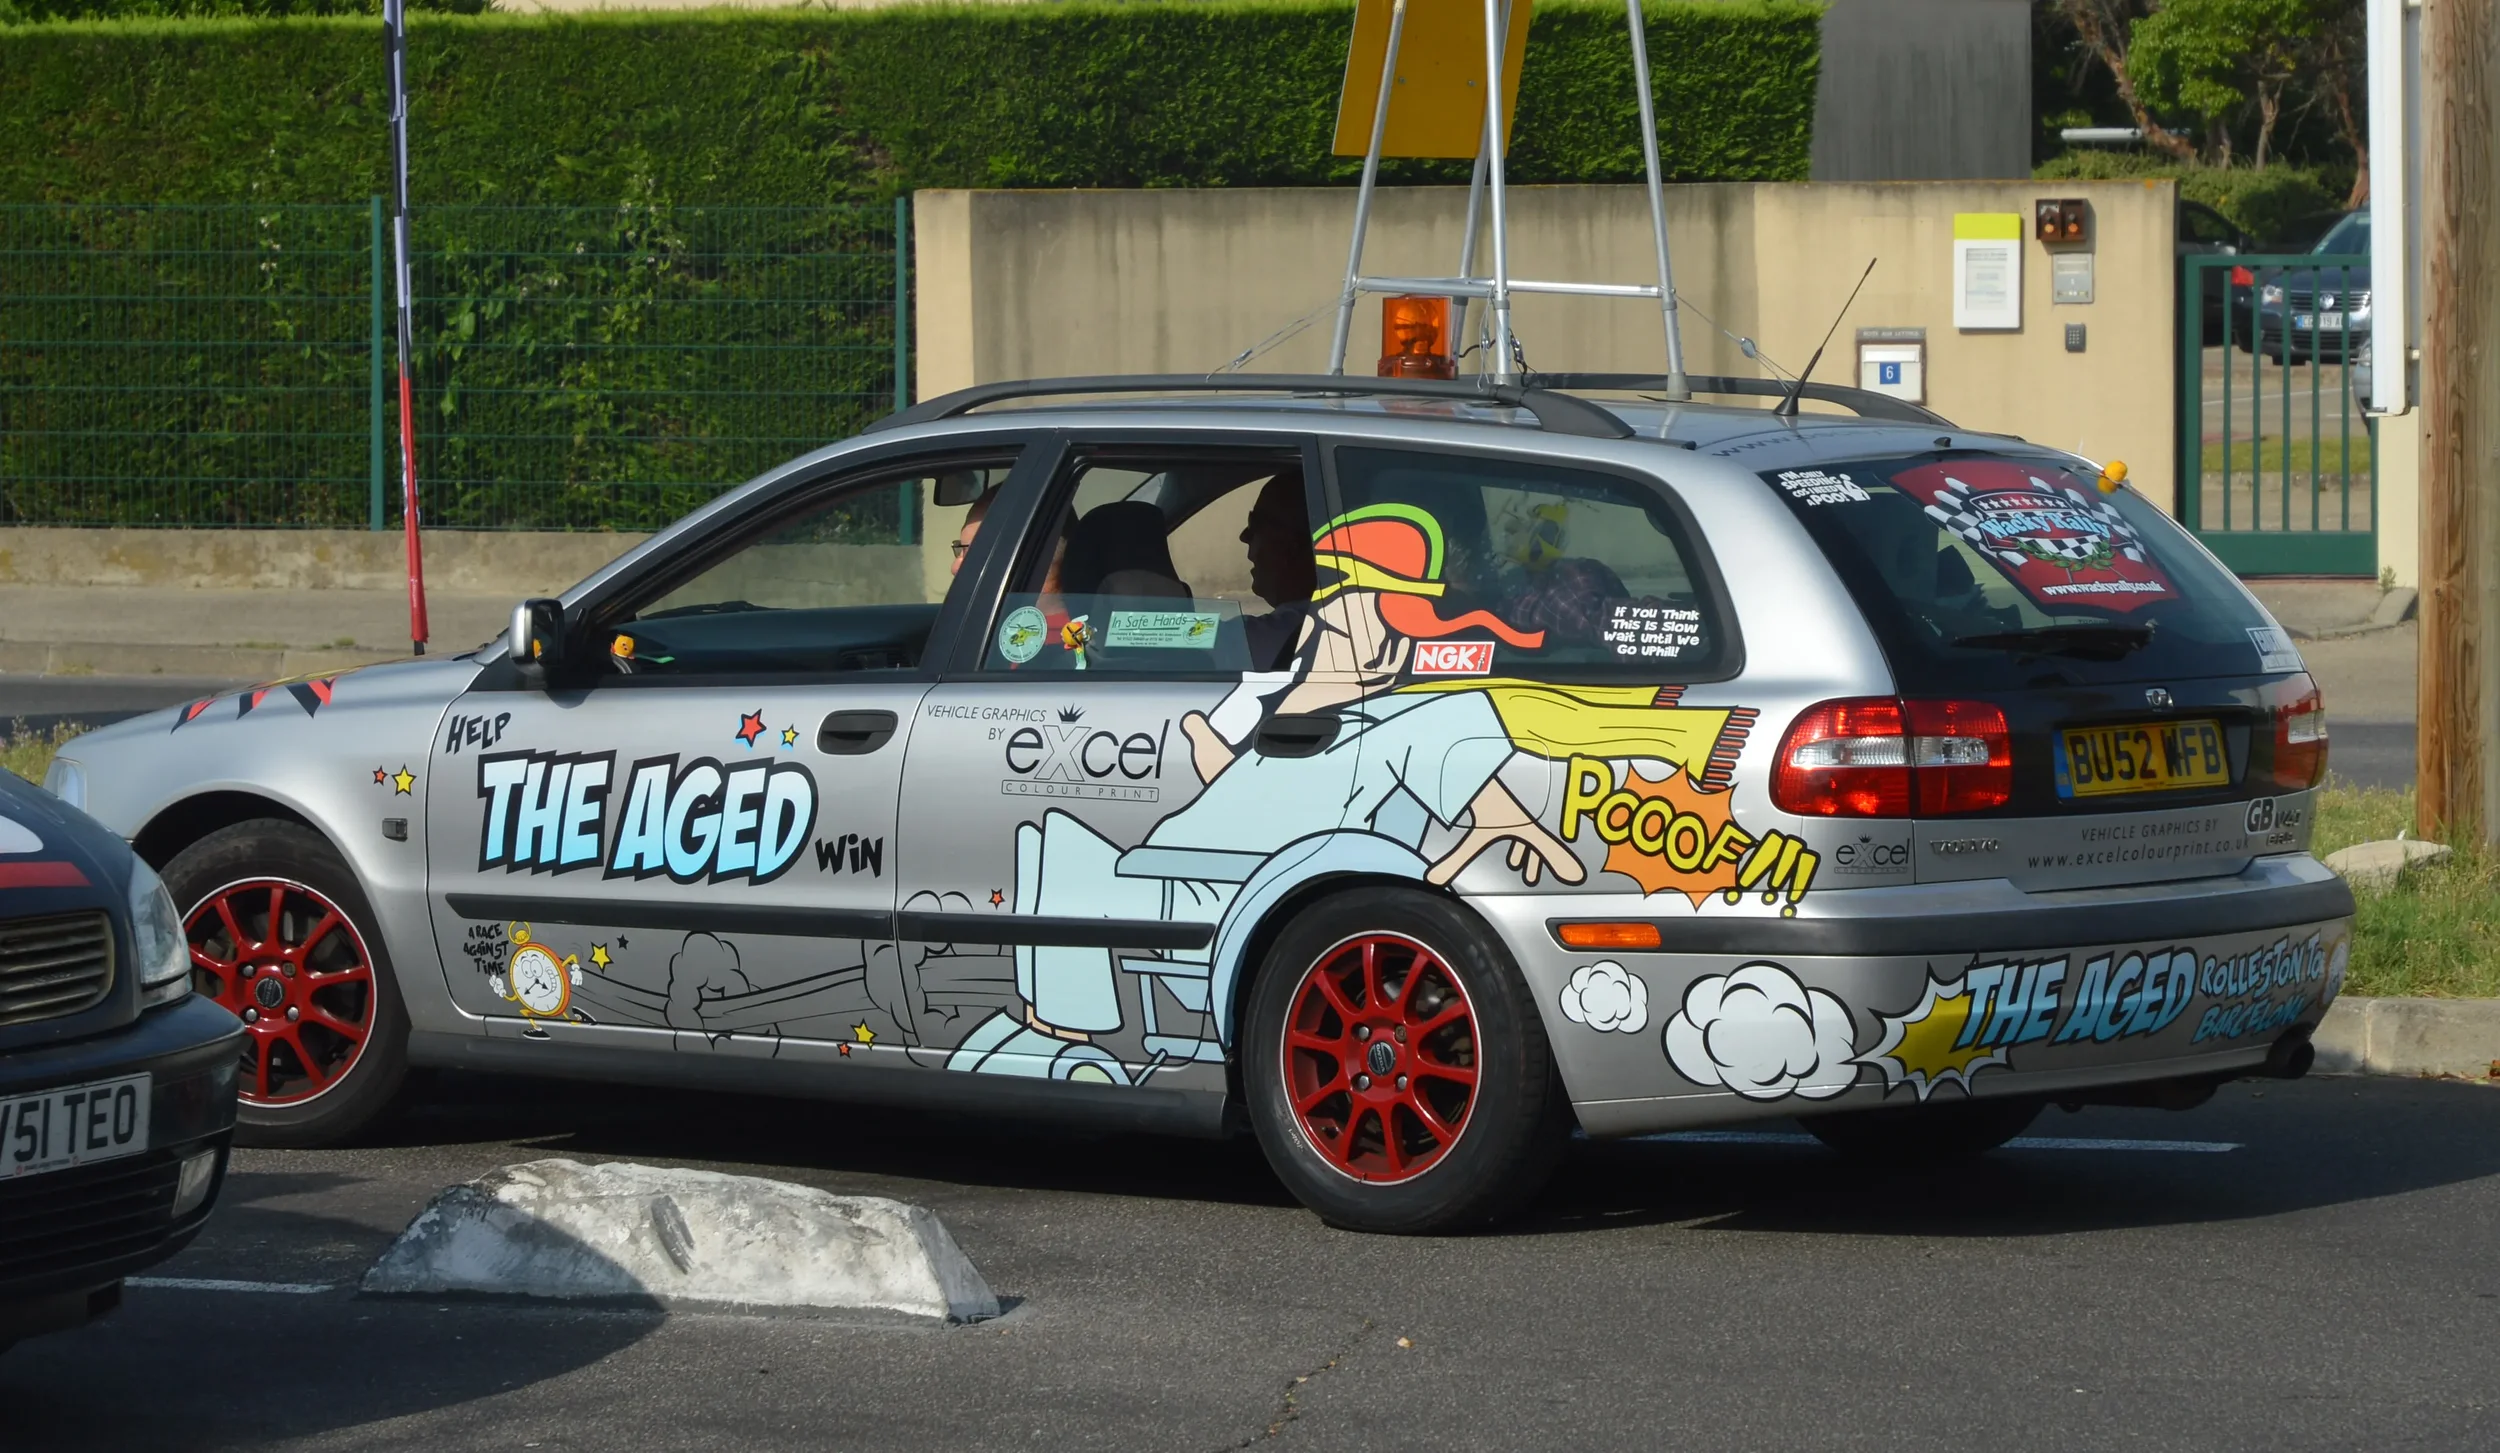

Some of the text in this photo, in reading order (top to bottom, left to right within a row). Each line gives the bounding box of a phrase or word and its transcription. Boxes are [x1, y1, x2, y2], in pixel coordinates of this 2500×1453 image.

[1885, 365, 1894, 379] 6
[1780, 476, 1842, 490] SPEEDING
[1799, 470, 1825, 478] ONLY
[1809, 492, 1850, 505] POO!
[1812, 485, 1839, 494] NEED
[1978, 512, 2111, 539] Wacky Rally
[2042, 580, 2166, 596] www.wackyrally.co.uk
[1112, 613, 1187, 629] In Safe Hands
[1416, 645, 1478, 671] NGK
[927, 705, 1047, 723] VEHICLE GRAPHICS
[446, 712, 511, 755] HELP
[988, 727, 1006, 741] BY
[2068, 730, 2157, 784] BU52
[1006, 783, 1155, 800] COLOUR PRINT
[478, 748, 617, 877] THE
[602, 753, 819, 887] AGED
[2246, 798, 2274, 832] GB
[2081, 818, 2219, 842] VEHICLE GRAPHICS BY
[2028, 836, 2249, 869] www.excelcolourprint.co.uk
[468, 923, 503, 940] A RACE
[1948, 946, 2199, 1054] THE AGED
[1375, 1042, 1386, 1073] VOLVO
[63, 1084, 137, 1154] TEO
